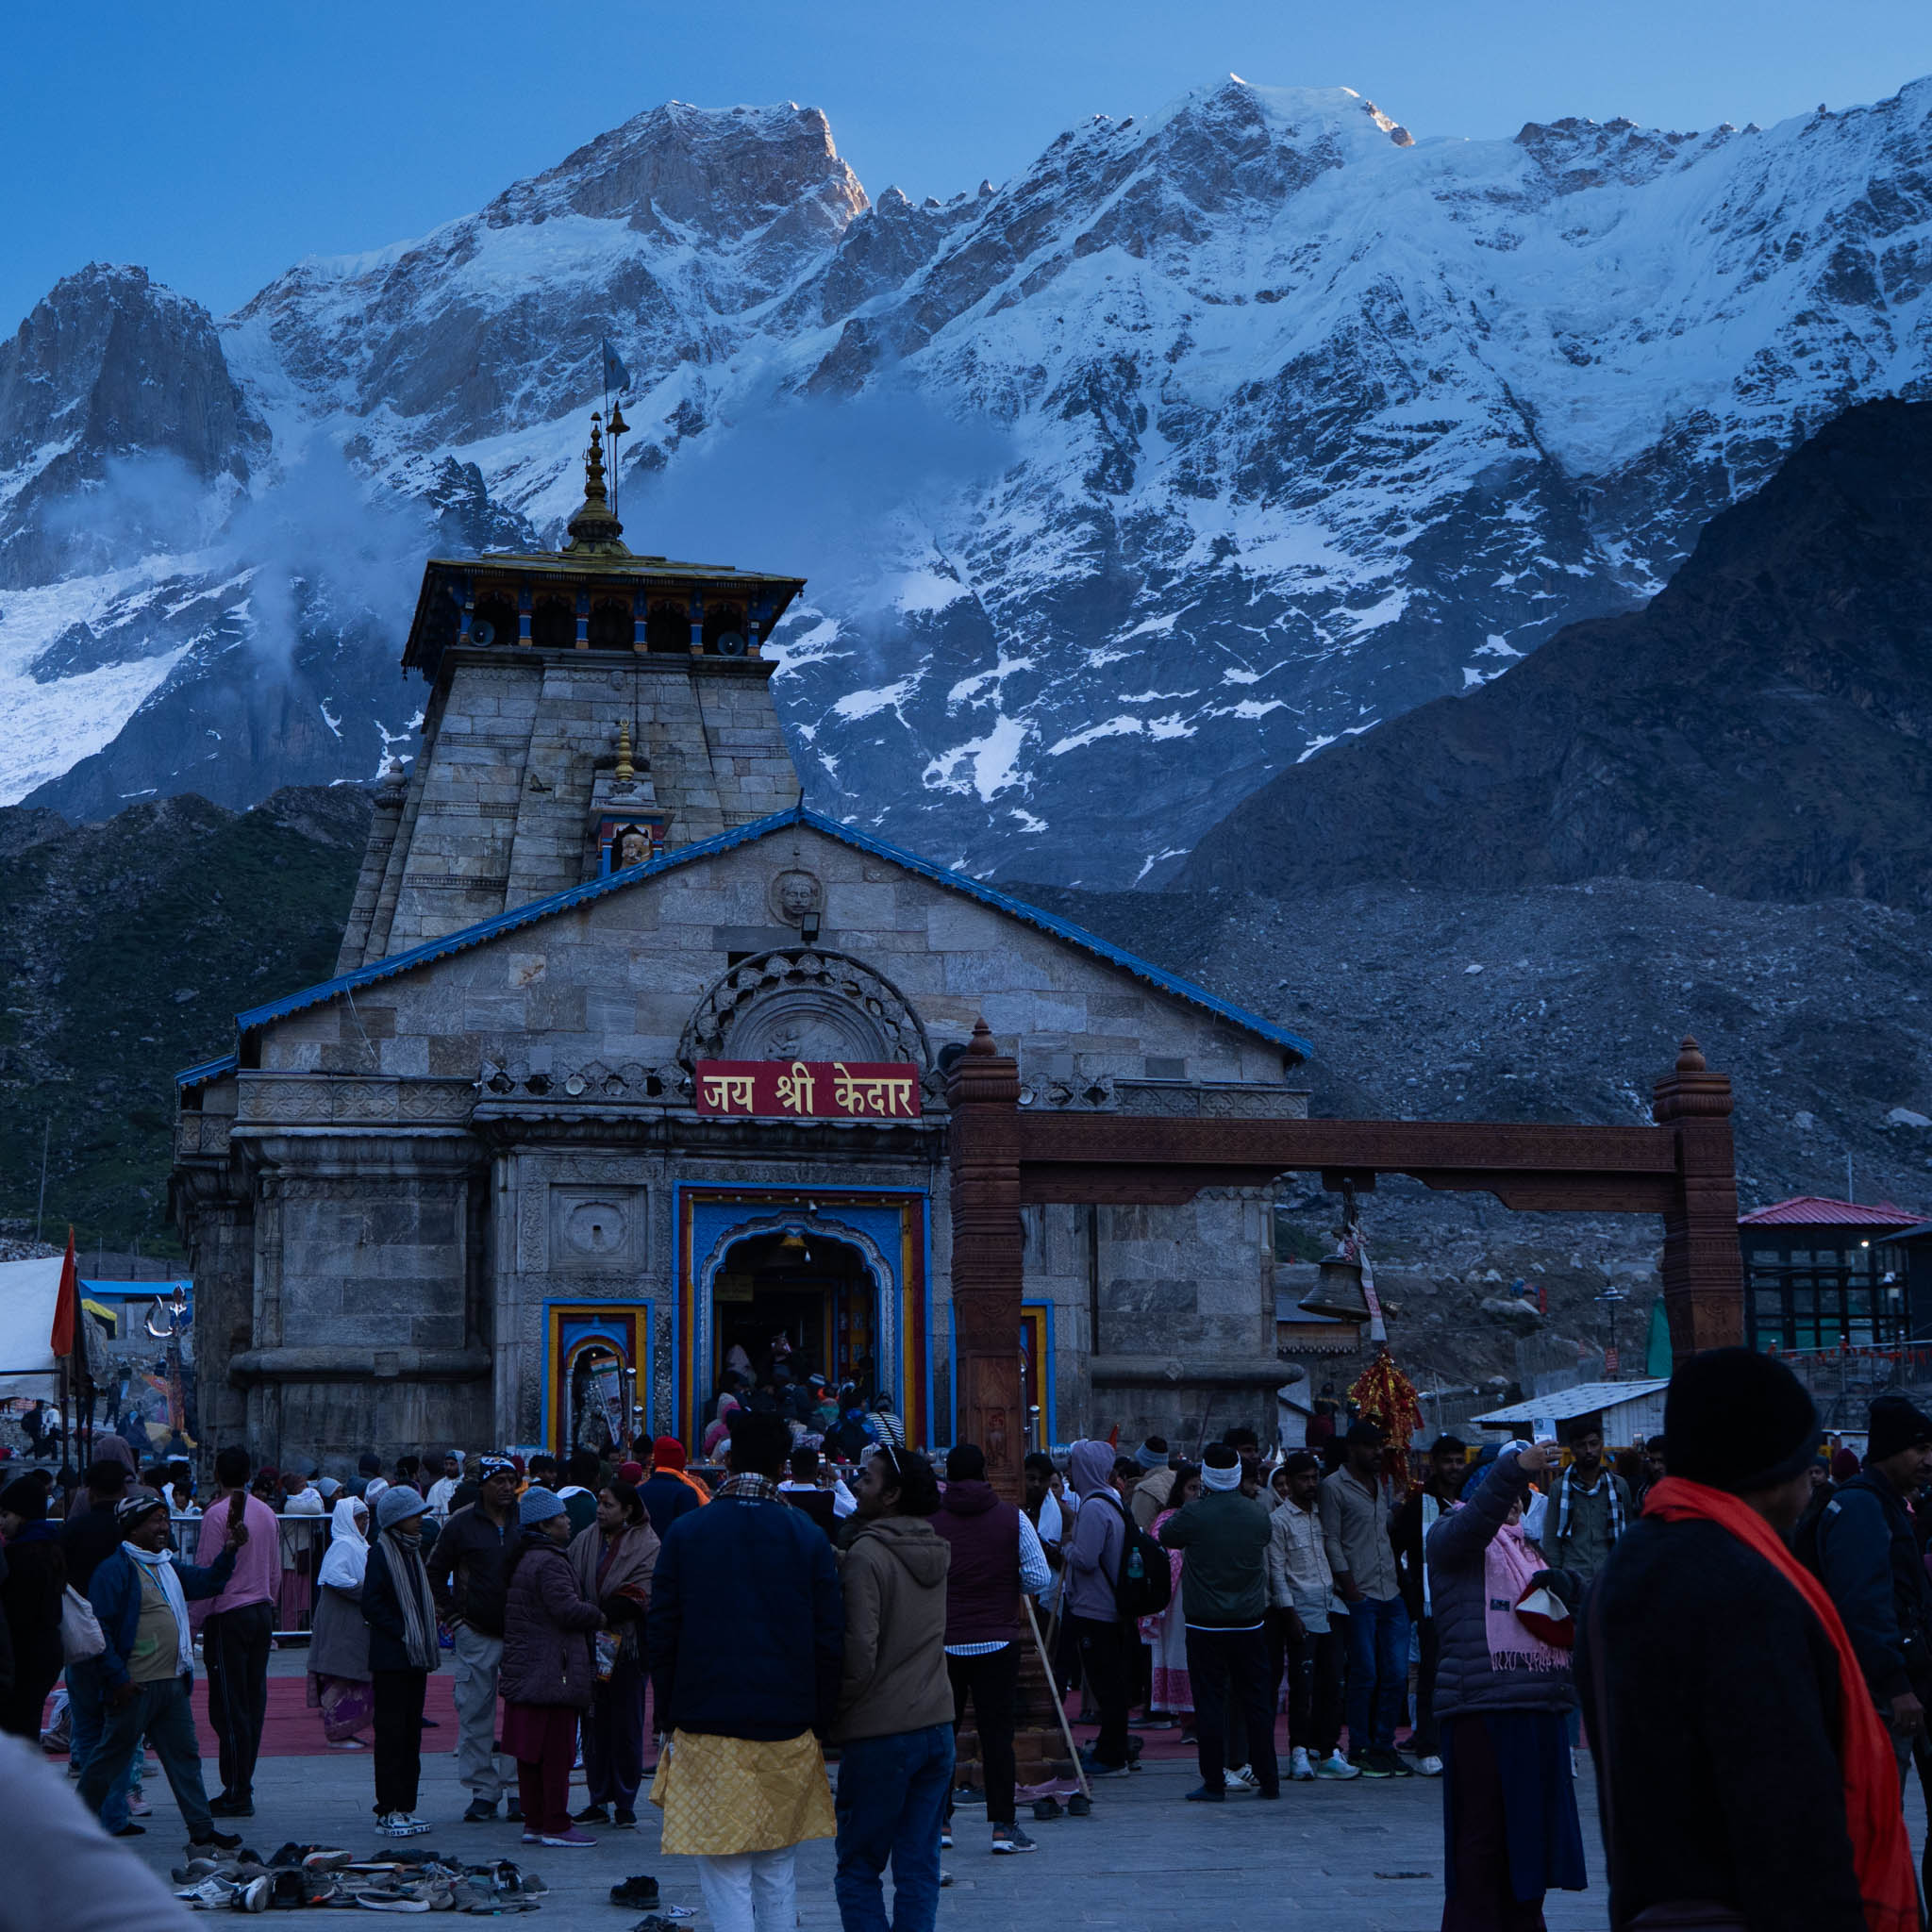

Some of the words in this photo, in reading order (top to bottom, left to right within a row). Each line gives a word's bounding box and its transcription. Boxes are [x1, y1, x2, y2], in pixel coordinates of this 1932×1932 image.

[703, 1075, 755, 1114] जय
[774, 1061, 815, 1115] श्री
[834, 1062, 913, 1116] केदार
